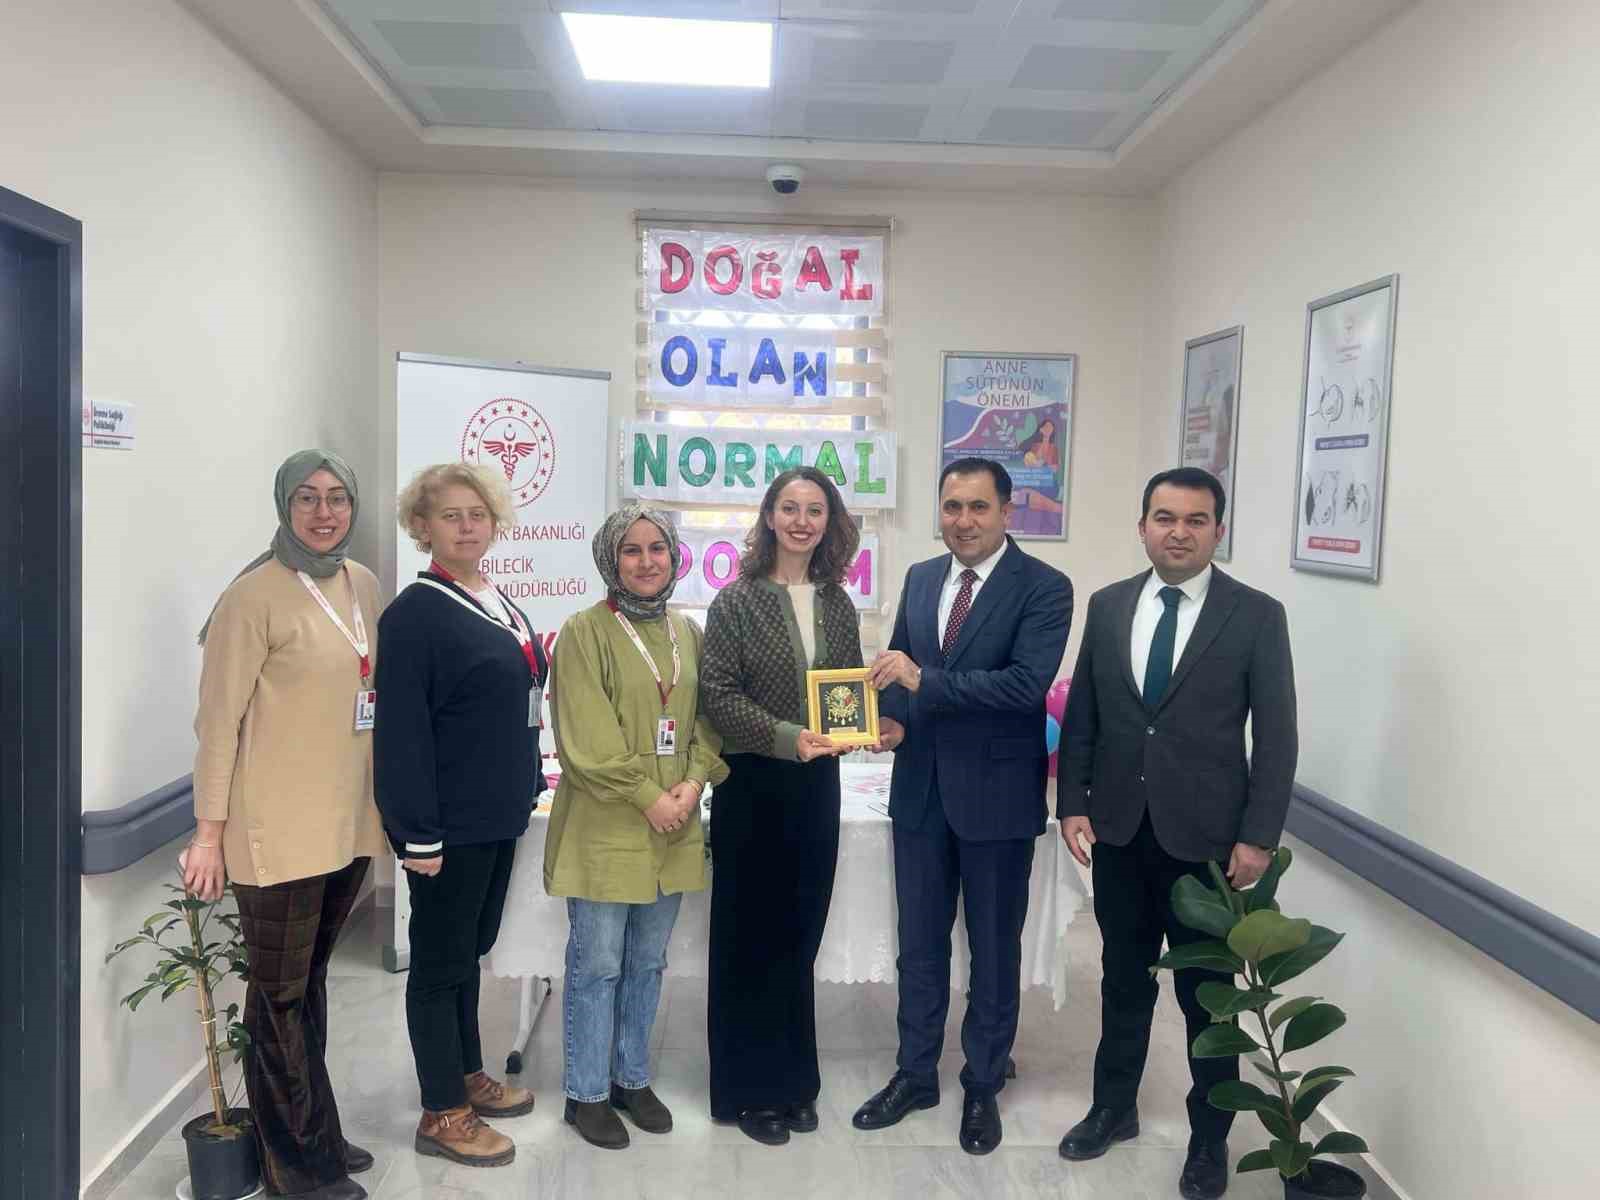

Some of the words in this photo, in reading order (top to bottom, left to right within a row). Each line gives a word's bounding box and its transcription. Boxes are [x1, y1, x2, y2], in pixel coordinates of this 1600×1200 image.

[660, 242, 873, 300] DOĞAL
[661, 335, 827, 396] OLAN
[984, 360, 1028, 374] ANNE
[966, 375, 1045, 391] SÜTÜNÜN
[977, 391, 1031, 407] ÖNEMİ
[633, 432, 886, 493] NORMAL
[512, 521, 585, 541] BAKANLIĞI
[481, 555, 534, 574] BİLECİK
